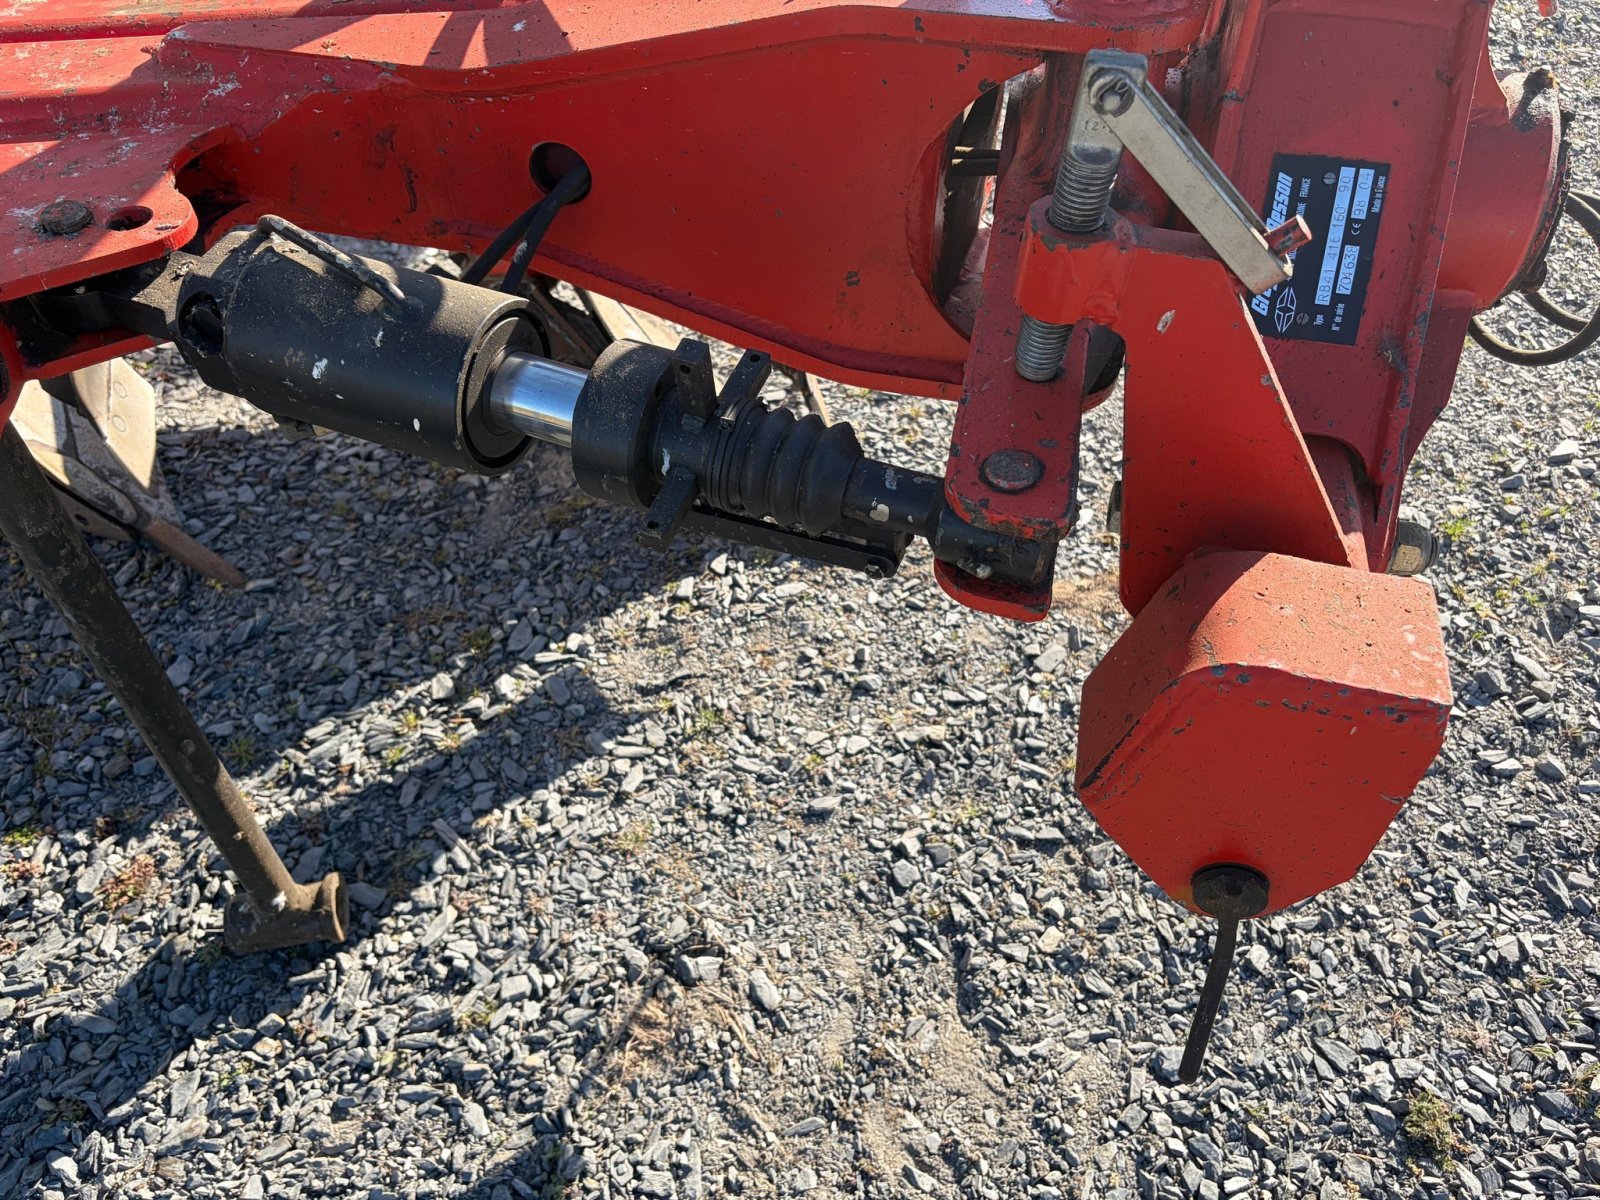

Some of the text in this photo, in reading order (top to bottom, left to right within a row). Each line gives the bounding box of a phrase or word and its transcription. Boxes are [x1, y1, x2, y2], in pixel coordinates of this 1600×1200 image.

[1299, 177, 1311, 198] FRANCE
[1338, 176, 1352, 193] 90
[1353, 172, 1371, 216] 98 04
[1371, 199, 1382, 213] Made
[1327, 236, 1341, 260] 416
[1317, 269, 1335, 302] RB41
[1335, 303, 1345, 316] série
[1313, 314, 1325, 326] Type
